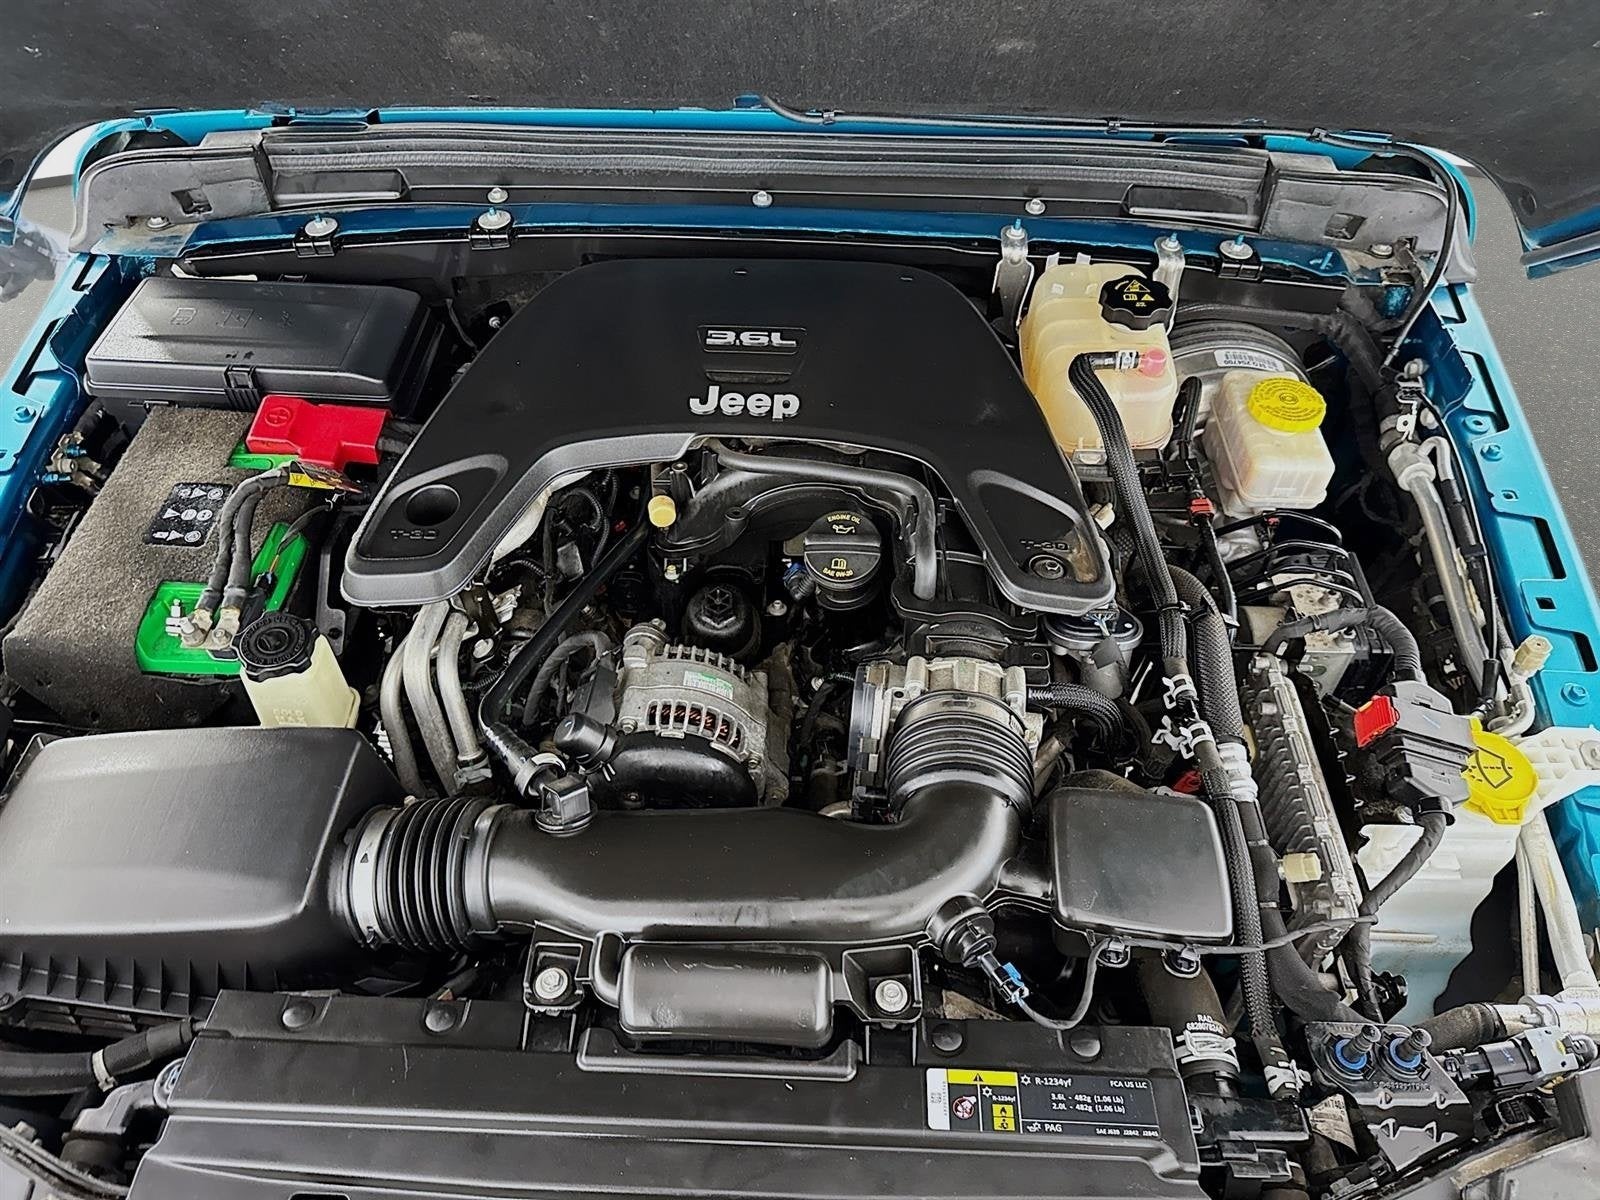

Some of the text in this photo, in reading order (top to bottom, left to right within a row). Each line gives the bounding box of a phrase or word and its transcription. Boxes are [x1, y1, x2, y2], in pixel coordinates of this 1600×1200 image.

[705, 330, 797, 347] 3.6L
[689, 385, 800, 422] Jeep
[827, 514, 861, 524] ENGINE OIL
[1197, 1014, 1213, 1022] RAD
[1035, 1077, 1072, 1088] R-1234yf
[1074, 1095, 1092, 1103] 482g
[1094, 1095, 1111, 1103] (1.06
[1112, 1096, 1124, 1104] Lb)
[1076, 1104, 1093, 1112] 482g
[1095, 1104, 1112, 1113] (1.06
[1114, 1105, 1125, 1114] Lb)
[1045, 1124, 1062, 1132] PAG
